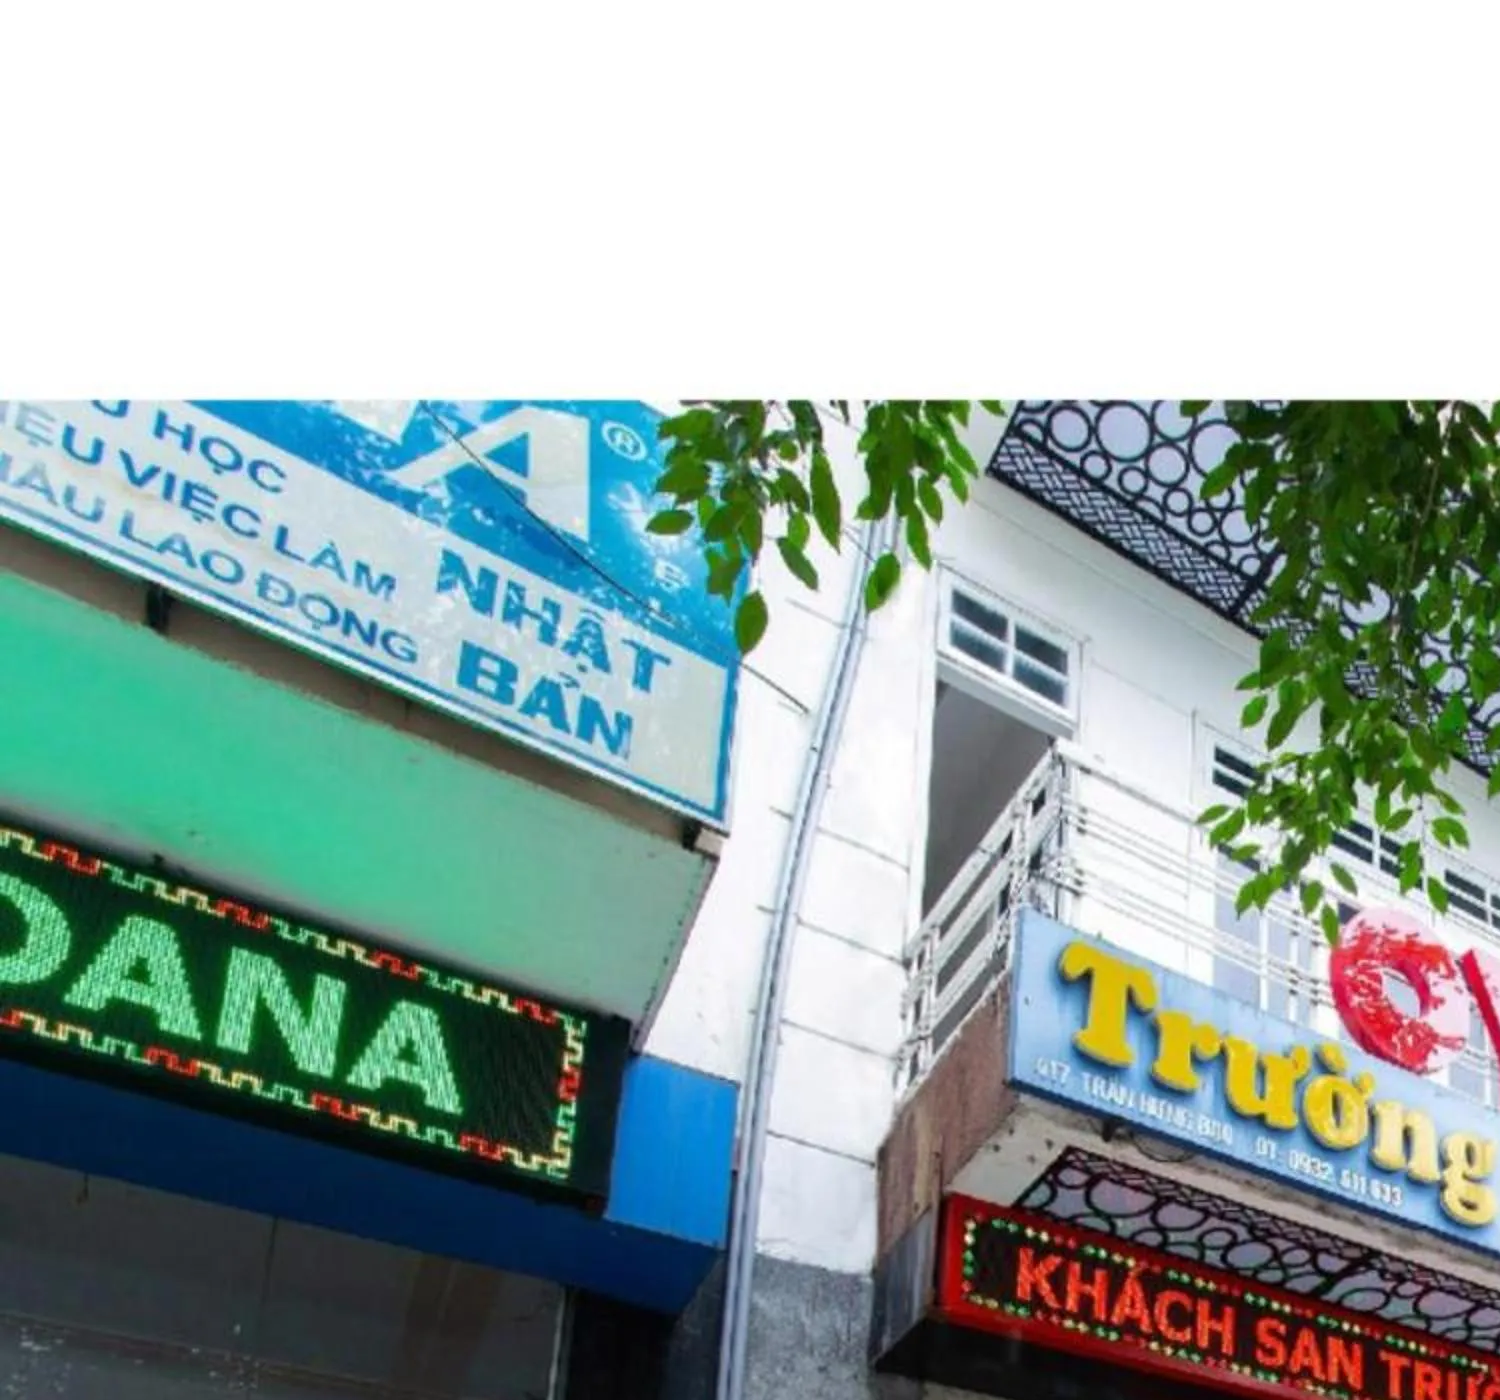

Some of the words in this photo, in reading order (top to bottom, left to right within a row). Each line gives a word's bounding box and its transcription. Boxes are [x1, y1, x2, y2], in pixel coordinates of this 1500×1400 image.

[153, 410, 286, 493] HỌC
[118, 509, 246, 586] LAO
[436, 548, 673, 694] NHẬT
[455, 639, 634, 761] BẢN
[1058, 940, 1497, 1228] Trường
[1015, 1246, 1237, 1356] KHÁCH
